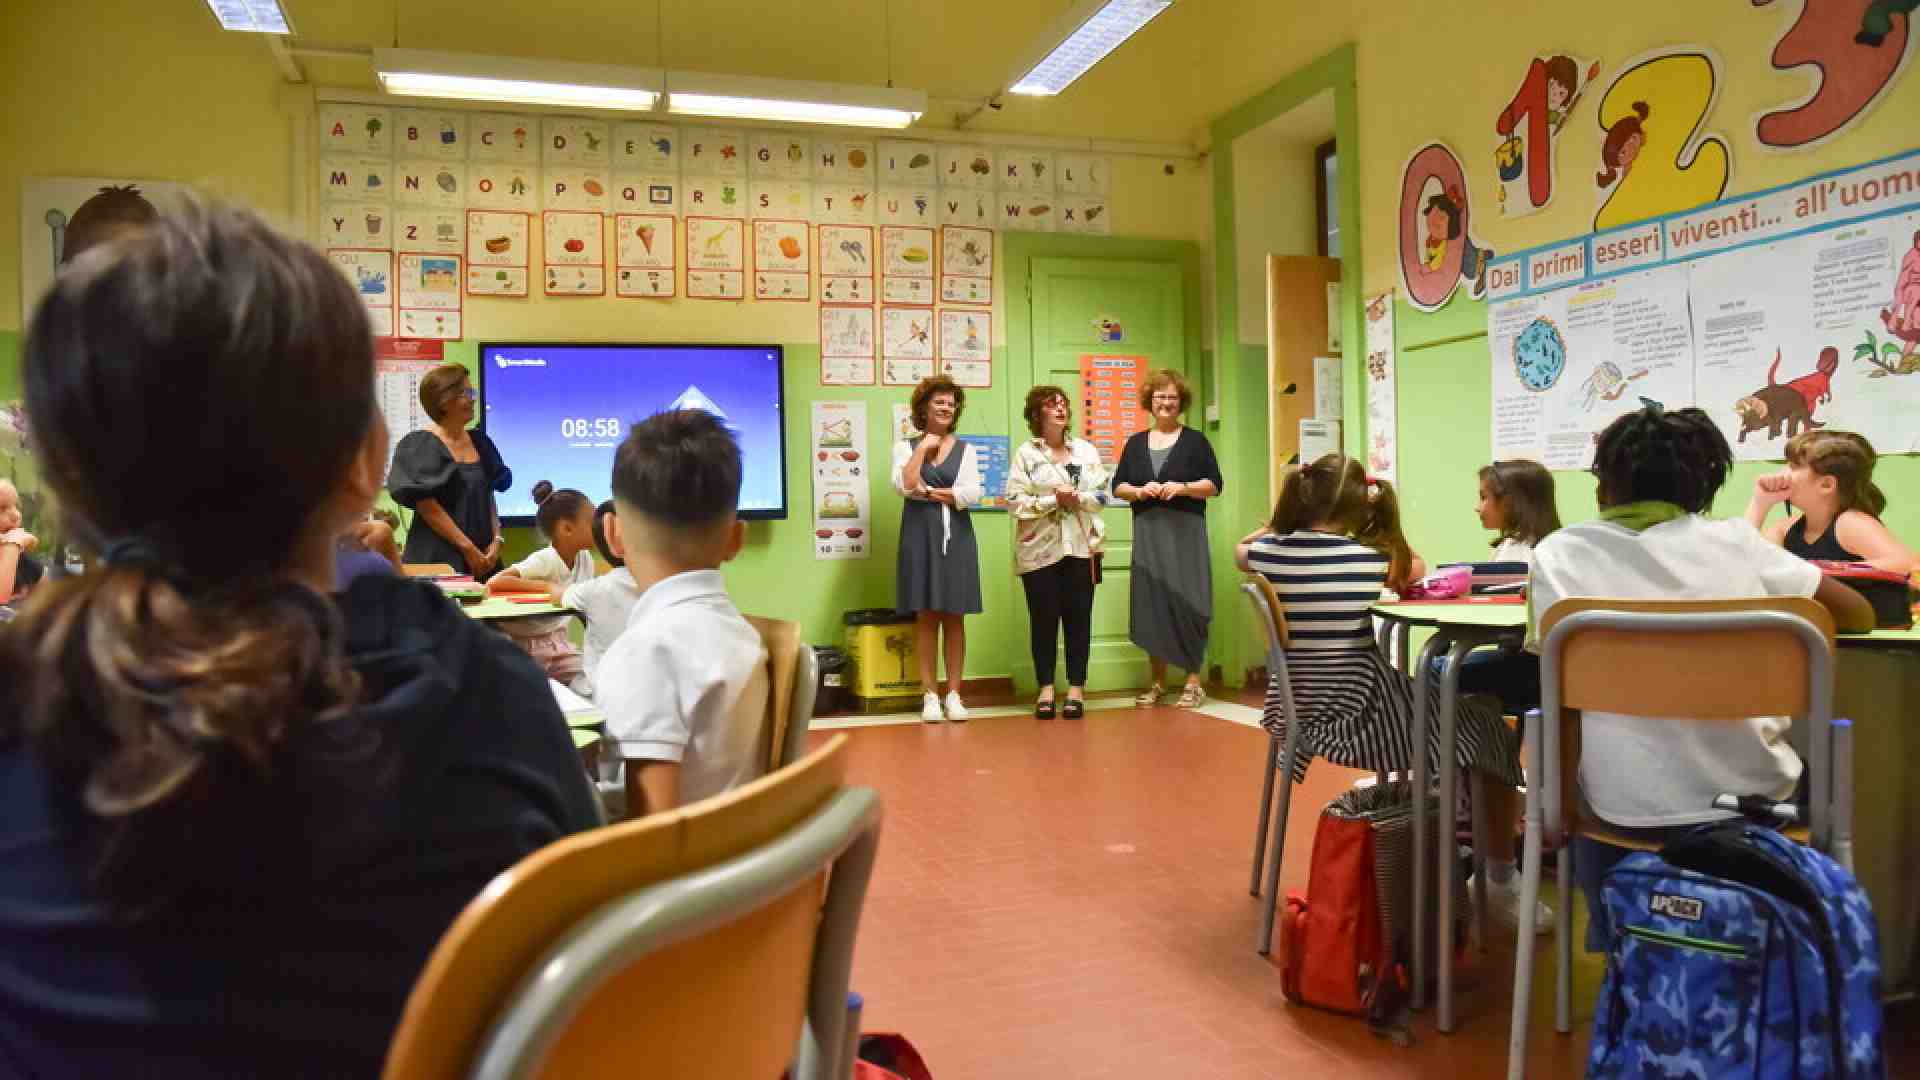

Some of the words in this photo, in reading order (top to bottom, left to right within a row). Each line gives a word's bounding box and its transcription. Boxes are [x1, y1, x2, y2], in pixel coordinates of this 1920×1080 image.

[330, 122, 345, 136] A
[407, 126, 418, 140] B
[1496, 57, 1552, 207] 1
[481, 131, 495, 145] C
[553, 135, 566, 149] D
[1595, 53, 1729, 232] 2
[625, 141, 635, 154] E
[693, 143, 703, 157] F
[757, 148, 770, 162] G
[822, 153, 835, 167] H
[888, 157, 895, 170] I
[948, 160, 957, 173] J
[1007, 164, 1017, 177] K
[330, 171, 347, 185] M
[1064, 168, 1073, 181] L
[405, 175, 419, 190] N
[479, 179, 493, 193] O
[555, 183, 567, 196] P
[622, 187, 635, 202] Q
[693, 189, 703, 203] R
[759, 193, 769, 208] S
[823, 197, 834, 210] T
[887, 200, 898, 214] U
[947, 201, 958, 214] V
[1006, 204, 1021, 216] W
[1064, 207, 1074, 220] X
[332, 217, 345, 232] Y
[405, 225, 416, 240] Z
[1490, 263, 1520, 289] Dai
[1532, 246, 1584, 283] primi
[1595, 228, 1660, 265] esseri
[561, 417, 620, 438] 08:58
